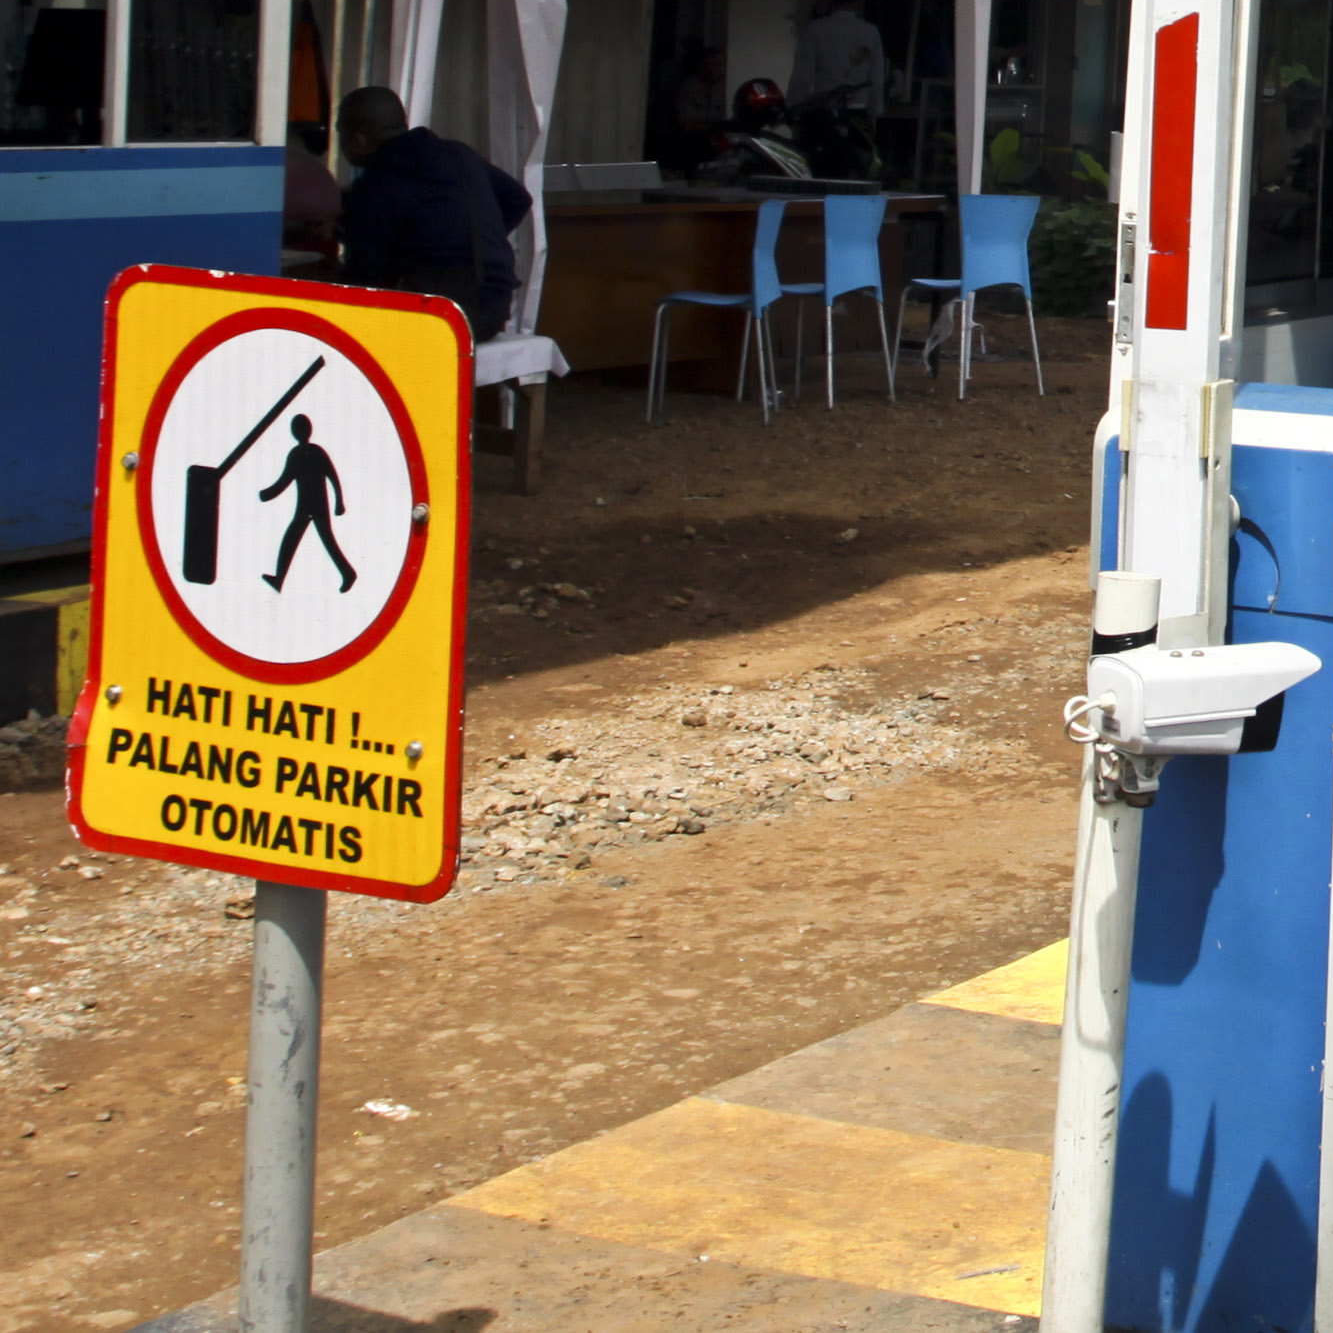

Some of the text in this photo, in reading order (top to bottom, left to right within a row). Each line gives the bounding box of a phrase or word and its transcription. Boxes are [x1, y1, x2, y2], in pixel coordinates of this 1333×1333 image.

[146, 676, 232, 727] HATI
[246, 694, 336, 745] HATI
[106, 727, 424, 818] PALANG PARKIR
[160, 794, 363, 863] OTOMATIS
